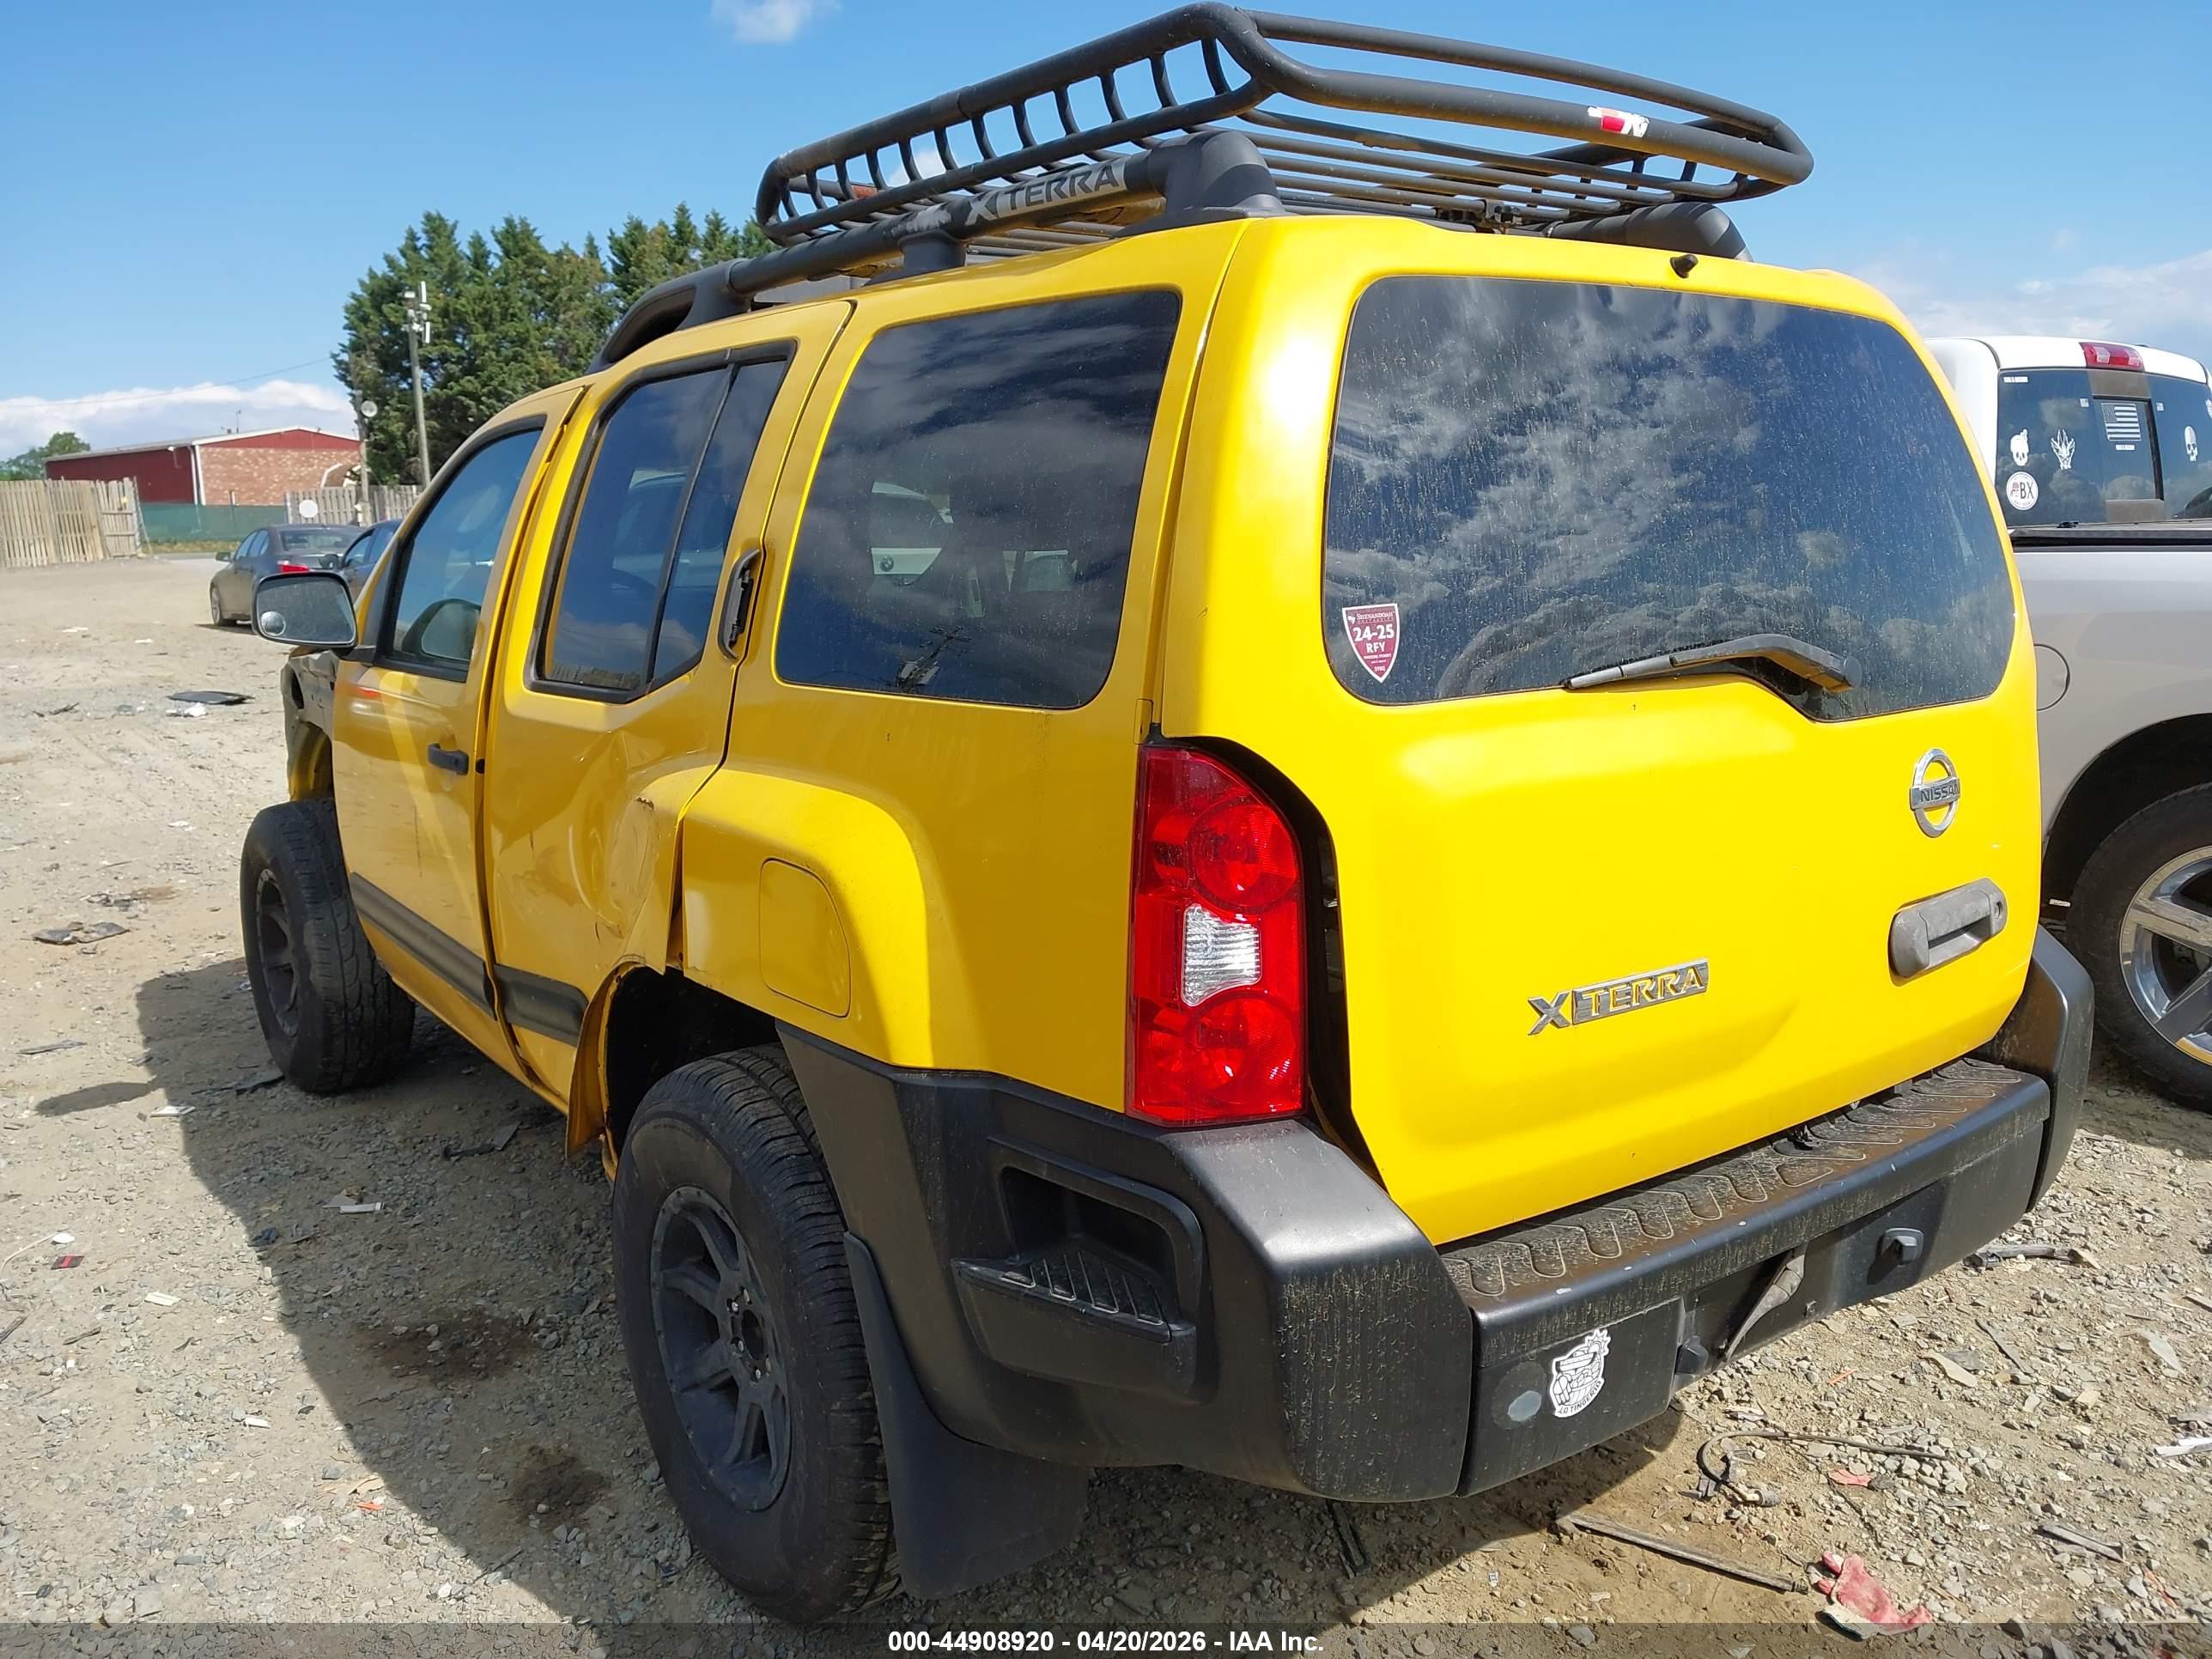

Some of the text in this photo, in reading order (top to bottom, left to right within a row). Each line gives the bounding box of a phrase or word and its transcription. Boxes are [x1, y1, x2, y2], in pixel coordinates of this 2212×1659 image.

[965, 164, 1123, 226] XTERRA
[1352, 623, 1395, 641] 24-25
[1366, 641, 1385, 653] RFY
[1920, 782, 1960, 802] NISSAN
[1528, 959, 1709, 1036] XTERRA
